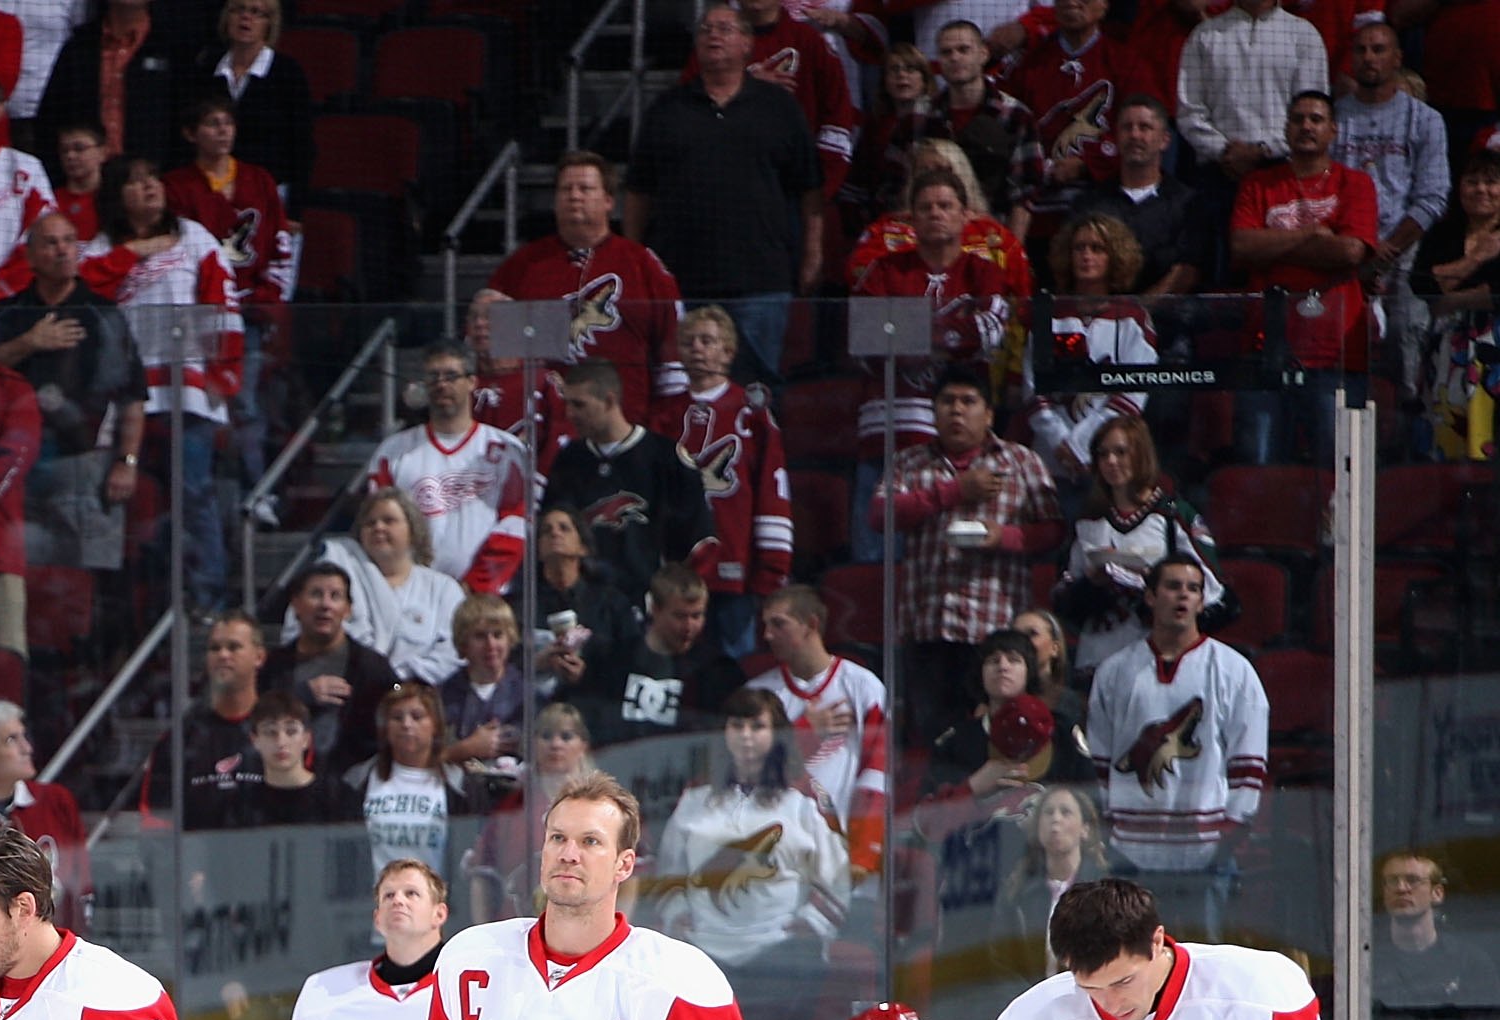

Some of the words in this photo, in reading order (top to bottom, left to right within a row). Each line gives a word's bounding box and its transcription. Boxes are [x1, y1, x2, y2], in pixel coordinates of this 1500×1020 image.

[1101, 371, 1216, 385] DAKTRONICS
[735, 406, 753, 438] C
[486, 440, 506, 464] C
